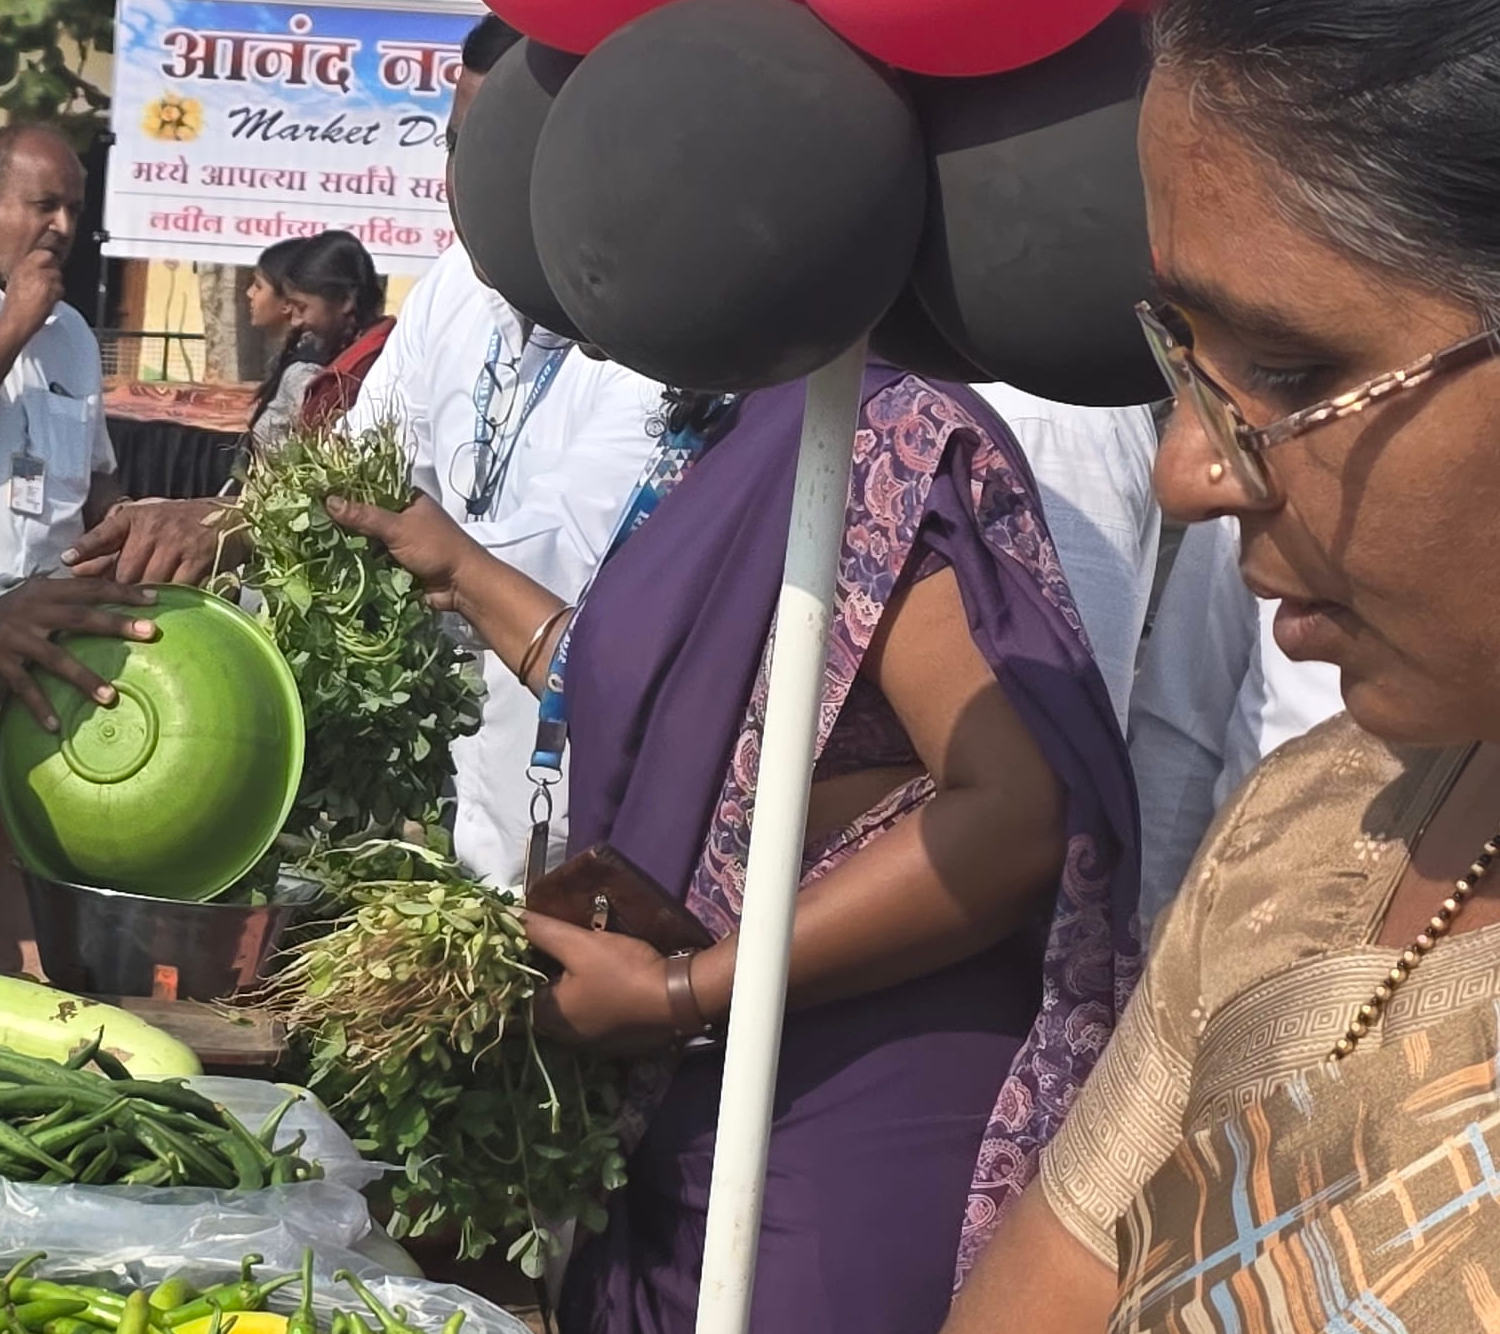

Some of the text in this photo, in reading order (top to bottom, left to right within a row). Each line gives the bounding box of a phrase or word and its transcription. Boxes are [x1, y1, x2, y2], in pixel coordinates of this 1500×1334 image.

[161, 13, 358, 93] आनंद
[227, 106, 454, 151] Market Da
[132, 155, 449, 204] मध्ये आपल्या सर्वांचे सह
